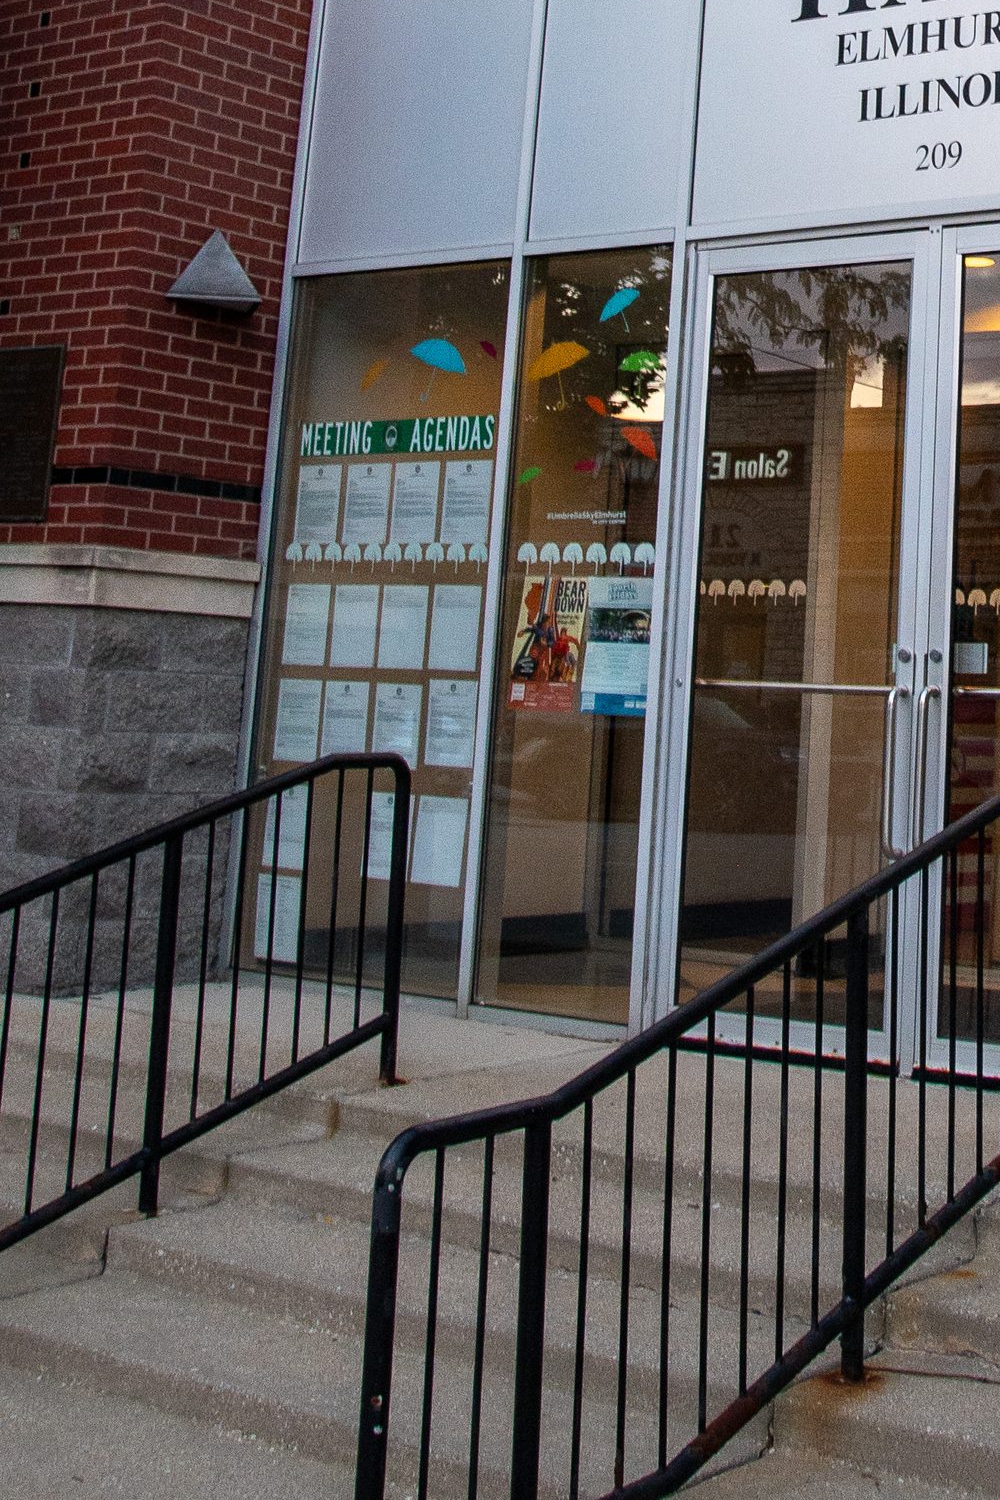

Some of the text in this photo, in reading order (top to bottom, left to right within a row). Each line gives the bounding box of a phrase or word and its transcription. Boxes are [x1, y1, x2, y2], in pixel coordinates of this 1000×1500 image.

[915, 141, 962, 171] 209
[301, 415, 495, 456] MEETING AGENDAS
[557, 581, 587, 598] BEAR
[554, 598, 585, 613] DOWN
